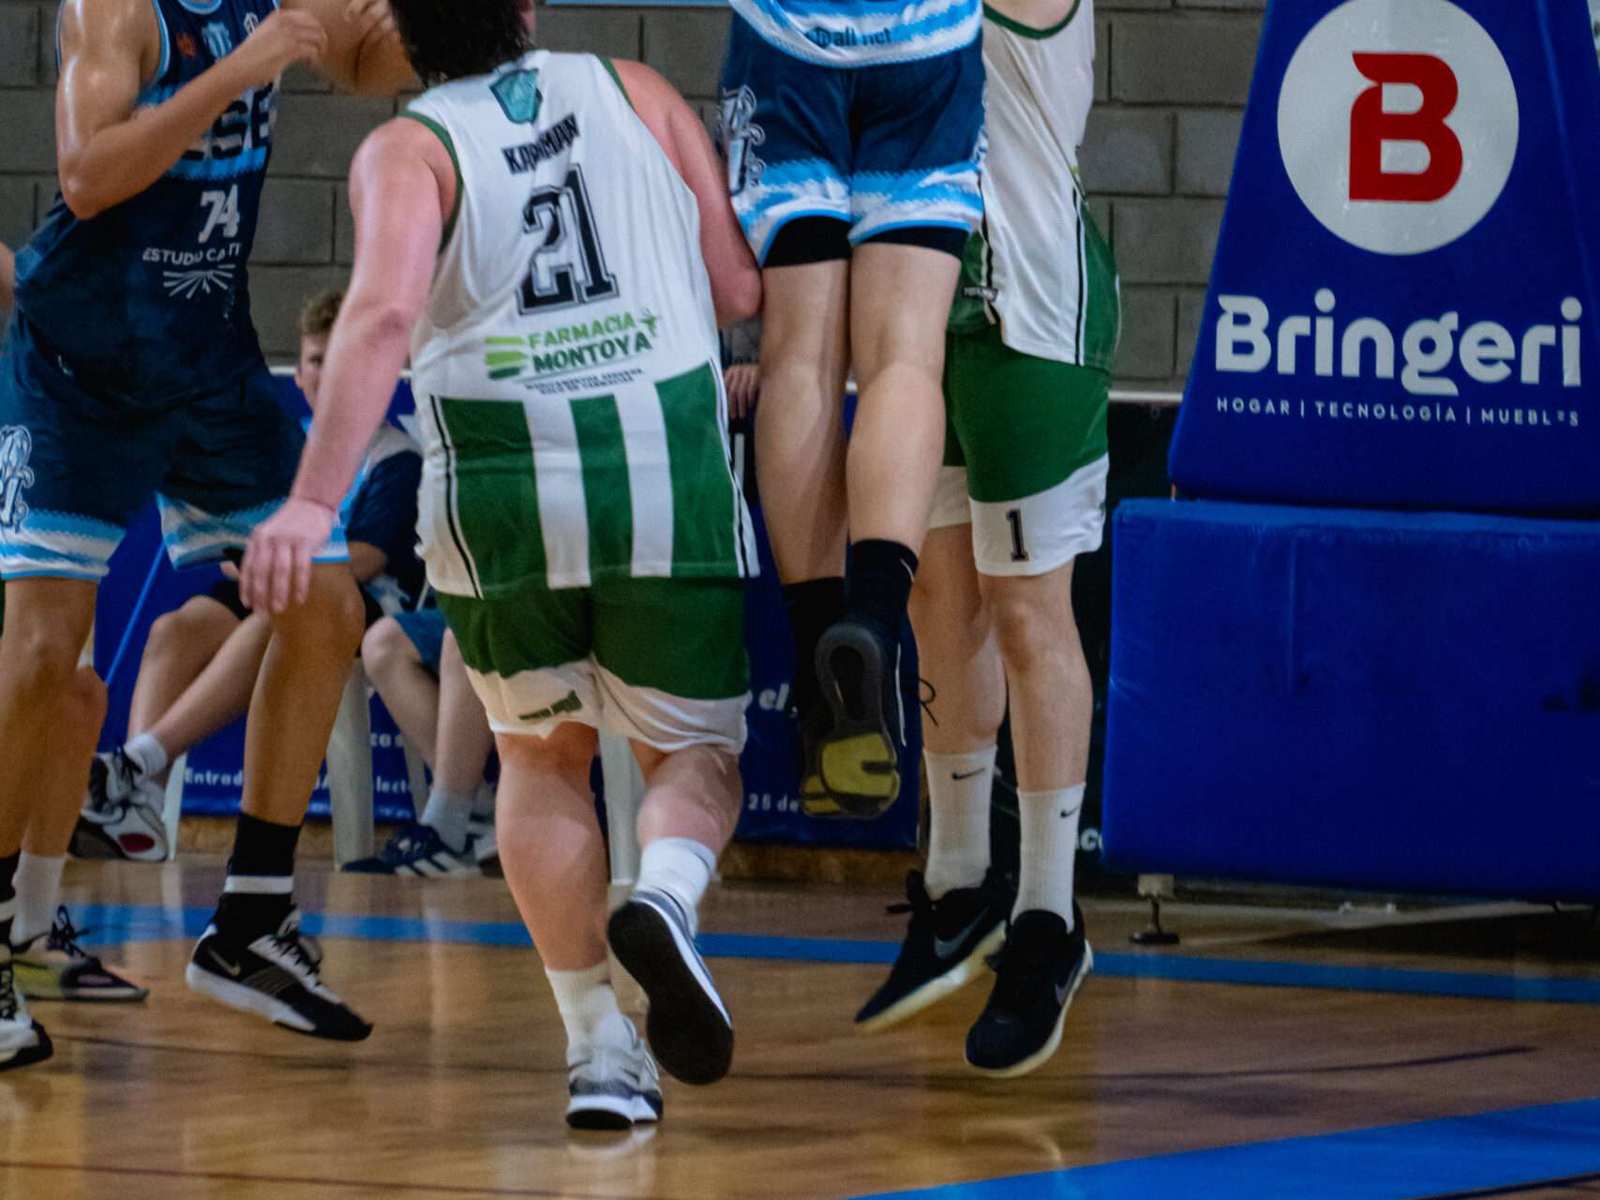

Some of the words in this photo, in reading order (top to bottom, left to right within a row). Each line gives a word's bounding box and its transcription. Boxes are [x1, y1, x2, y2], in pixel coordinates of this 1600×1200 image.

[1349, 51, 1463, 202] B
[515, 163, 620, 316] 21
[527, 311, 636, 349] FARMACIA
[532, 331, 652, 373] MONTOYA
[1215, 287, 1583, 397] Bringeri
[1217, 397, 1291, 416] HOGAR
[1006, 509, 1029, 562] 1
